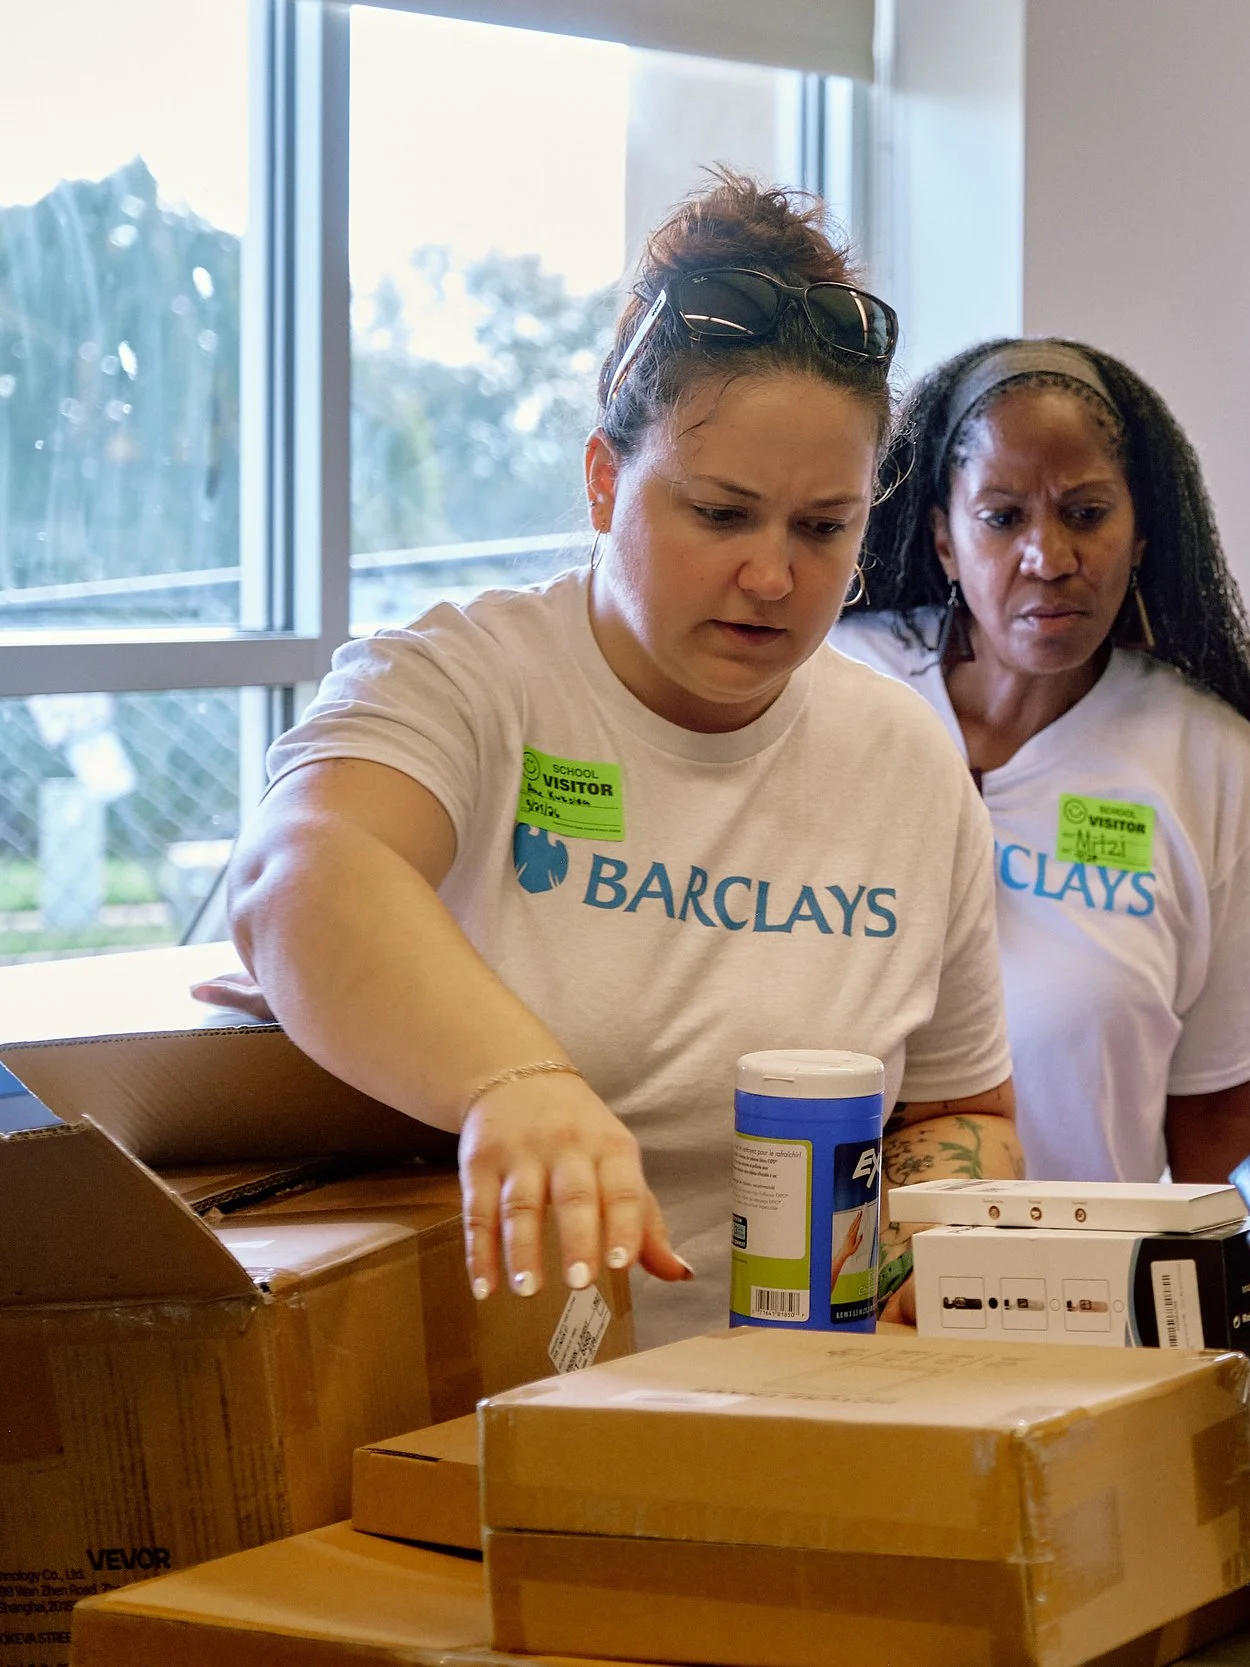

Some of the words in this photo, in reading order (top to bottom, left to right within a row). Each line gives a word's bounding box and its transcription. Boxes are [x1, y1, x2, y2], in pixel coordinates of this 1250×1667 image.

[553, 764, 599, 779] SCHOOL
[543, 773, 613, 797] VISITOR
[1089, 815, 1146, 834] VISITOR
[995, 842, 1157, 917] CLAYS
[582, 852, 897, 938] BARCLAYS
[86, 1548, 171, 1571] VEVOR
[38, 1631, 72, 1643] STREE
